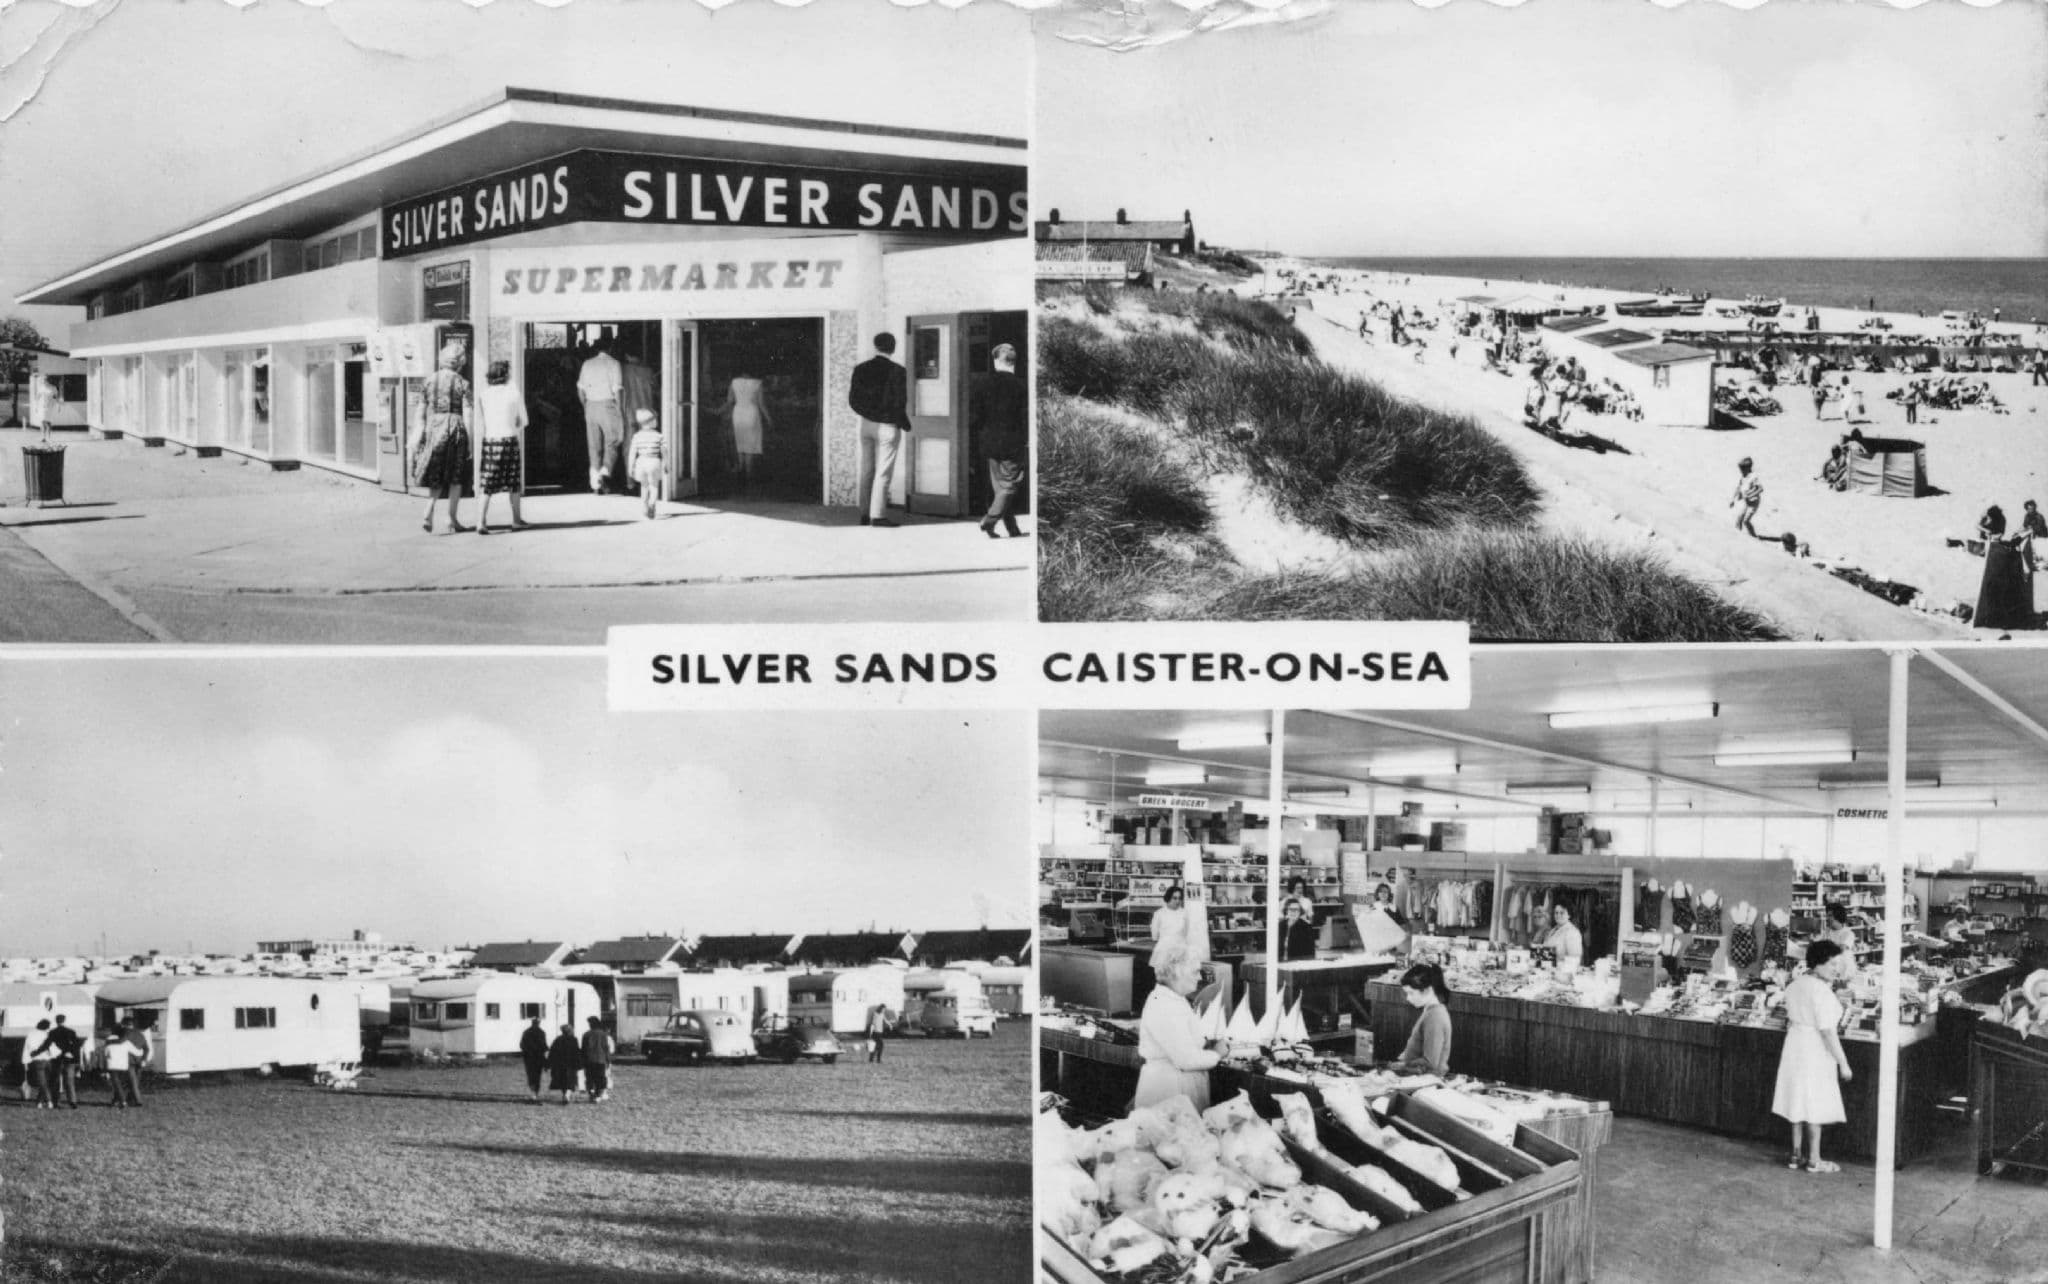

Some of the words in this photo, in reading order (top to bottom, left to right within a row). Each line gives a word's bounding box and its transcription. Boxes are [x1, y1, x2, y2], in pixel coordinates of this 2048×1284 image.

[391, 195, 464, 249] SILVER
[474, 166, 569, 231] SANDS
[624, 170, 831, 226] SILVER
[858, 182, 1027, 232] SANDS
[502, 259, 843, 295] SUPERMARKET
[1837, 808, 1888, 819] COSMETIC
